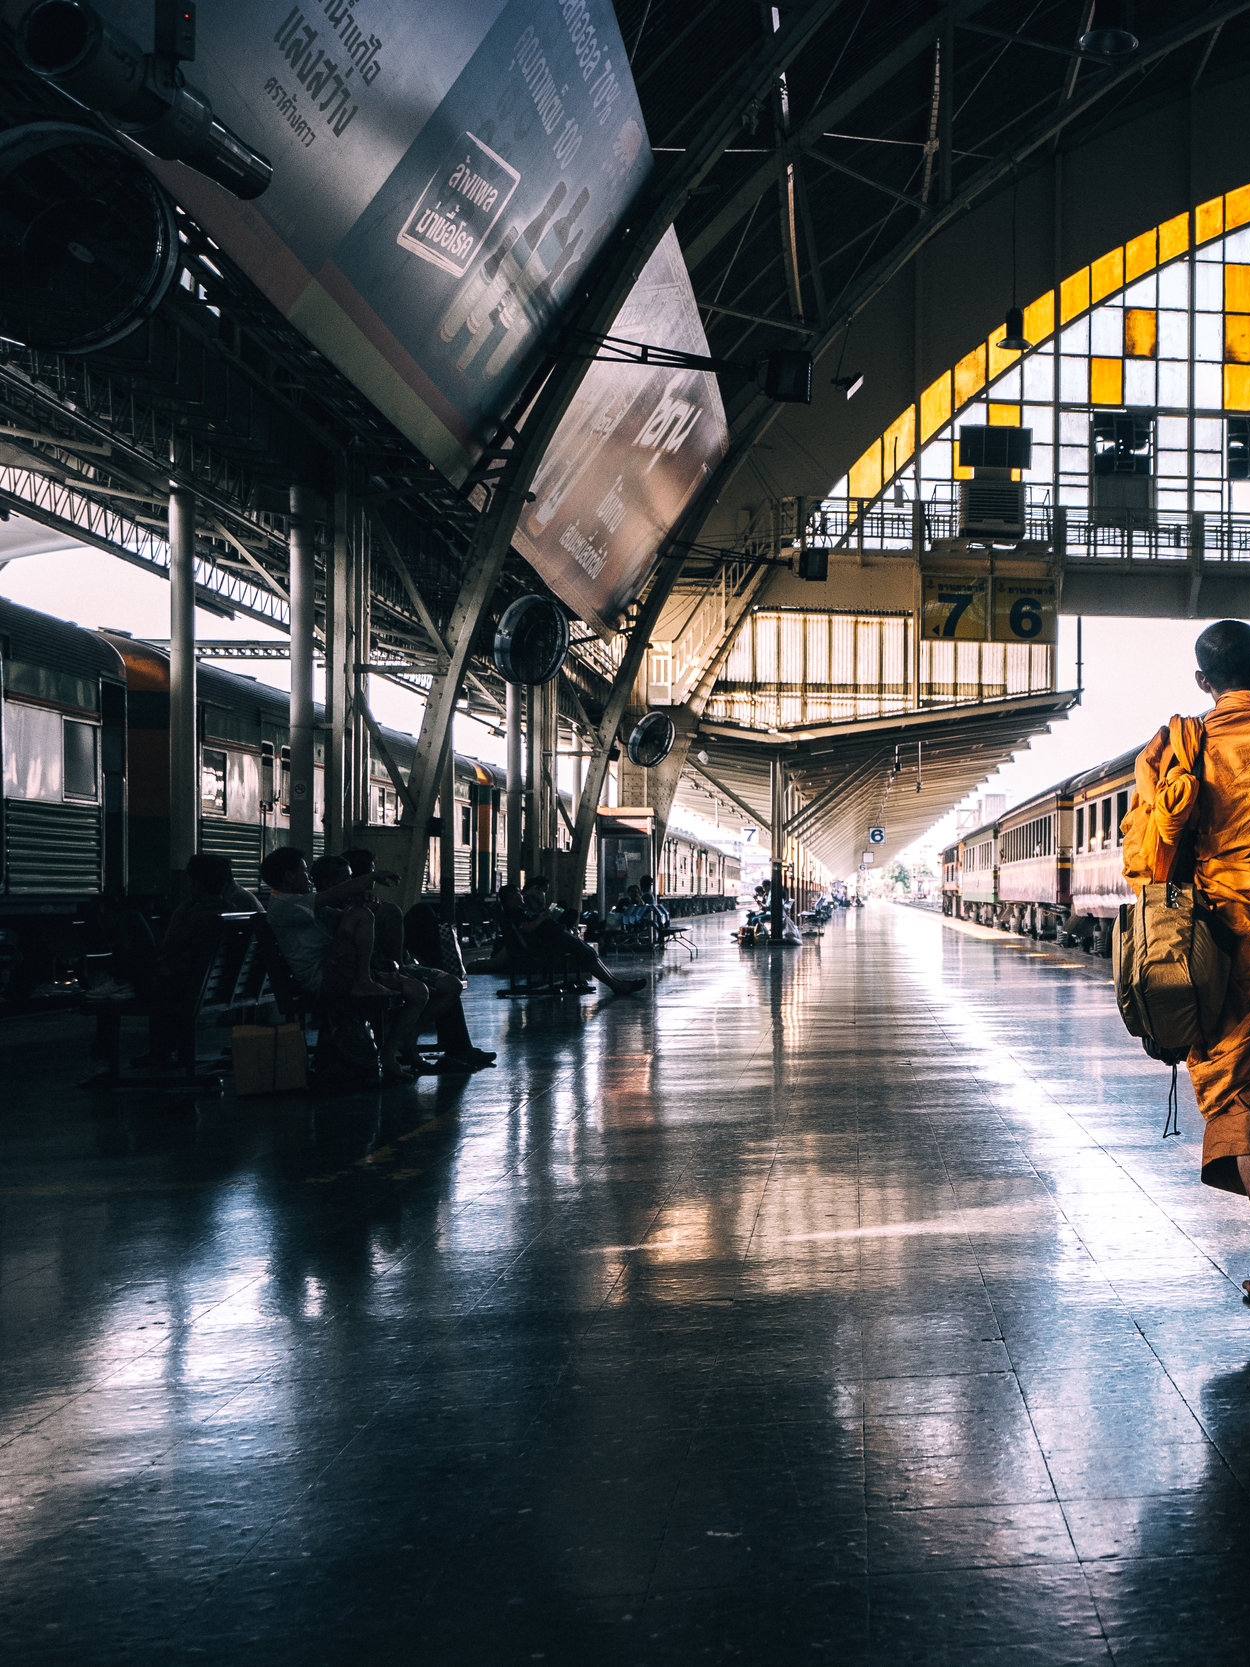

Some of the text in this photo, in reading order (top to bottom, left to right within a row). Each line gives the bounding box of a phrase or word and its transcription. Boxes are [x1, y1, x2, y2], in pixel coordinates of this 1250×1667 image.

[273, 5, 359, 138] แสงสว่าง
[264, 76, 316, 148] ตราค้างคาว
[553, 117, 583, 170] 100
[448, 154, 499, 213] ล้างแผล
[417, 201, 474, 260] ฆ่าเชื้อโรค
[938, 593, 974, 637] 7
[1009, 597, 1043, 639] 6
[743, 828, 757, 842] 7
[870, 829, 885, 843] 6
